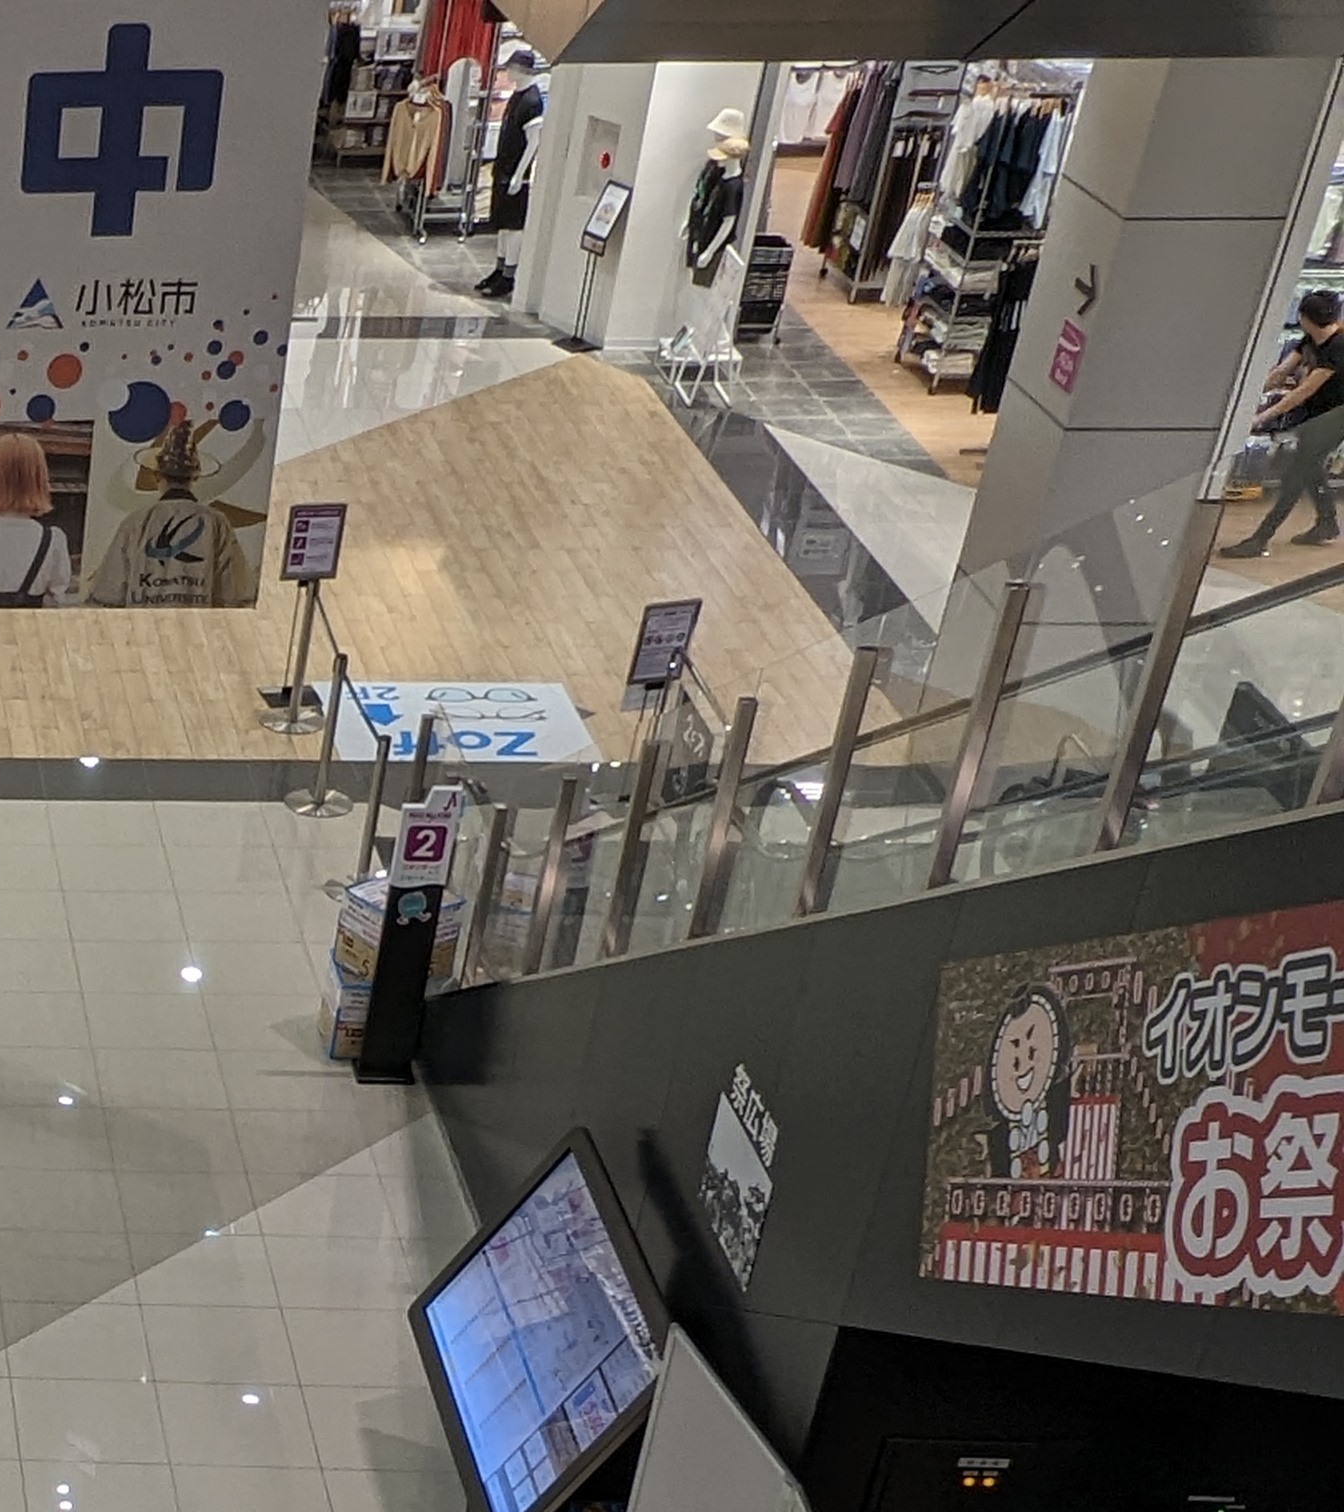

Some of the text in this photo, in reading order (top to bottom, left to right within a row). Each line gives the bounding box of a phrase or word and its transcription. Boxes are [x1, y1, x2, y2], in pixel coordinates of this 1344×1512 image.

[21, 23, 224, 237] 中
[75, 278, 199, 316] 小松市
[146, 319, 175, 328] CITY
[411, 828, 438, 859] 2
[1147, 950, 1344, 1080] イオンモ
